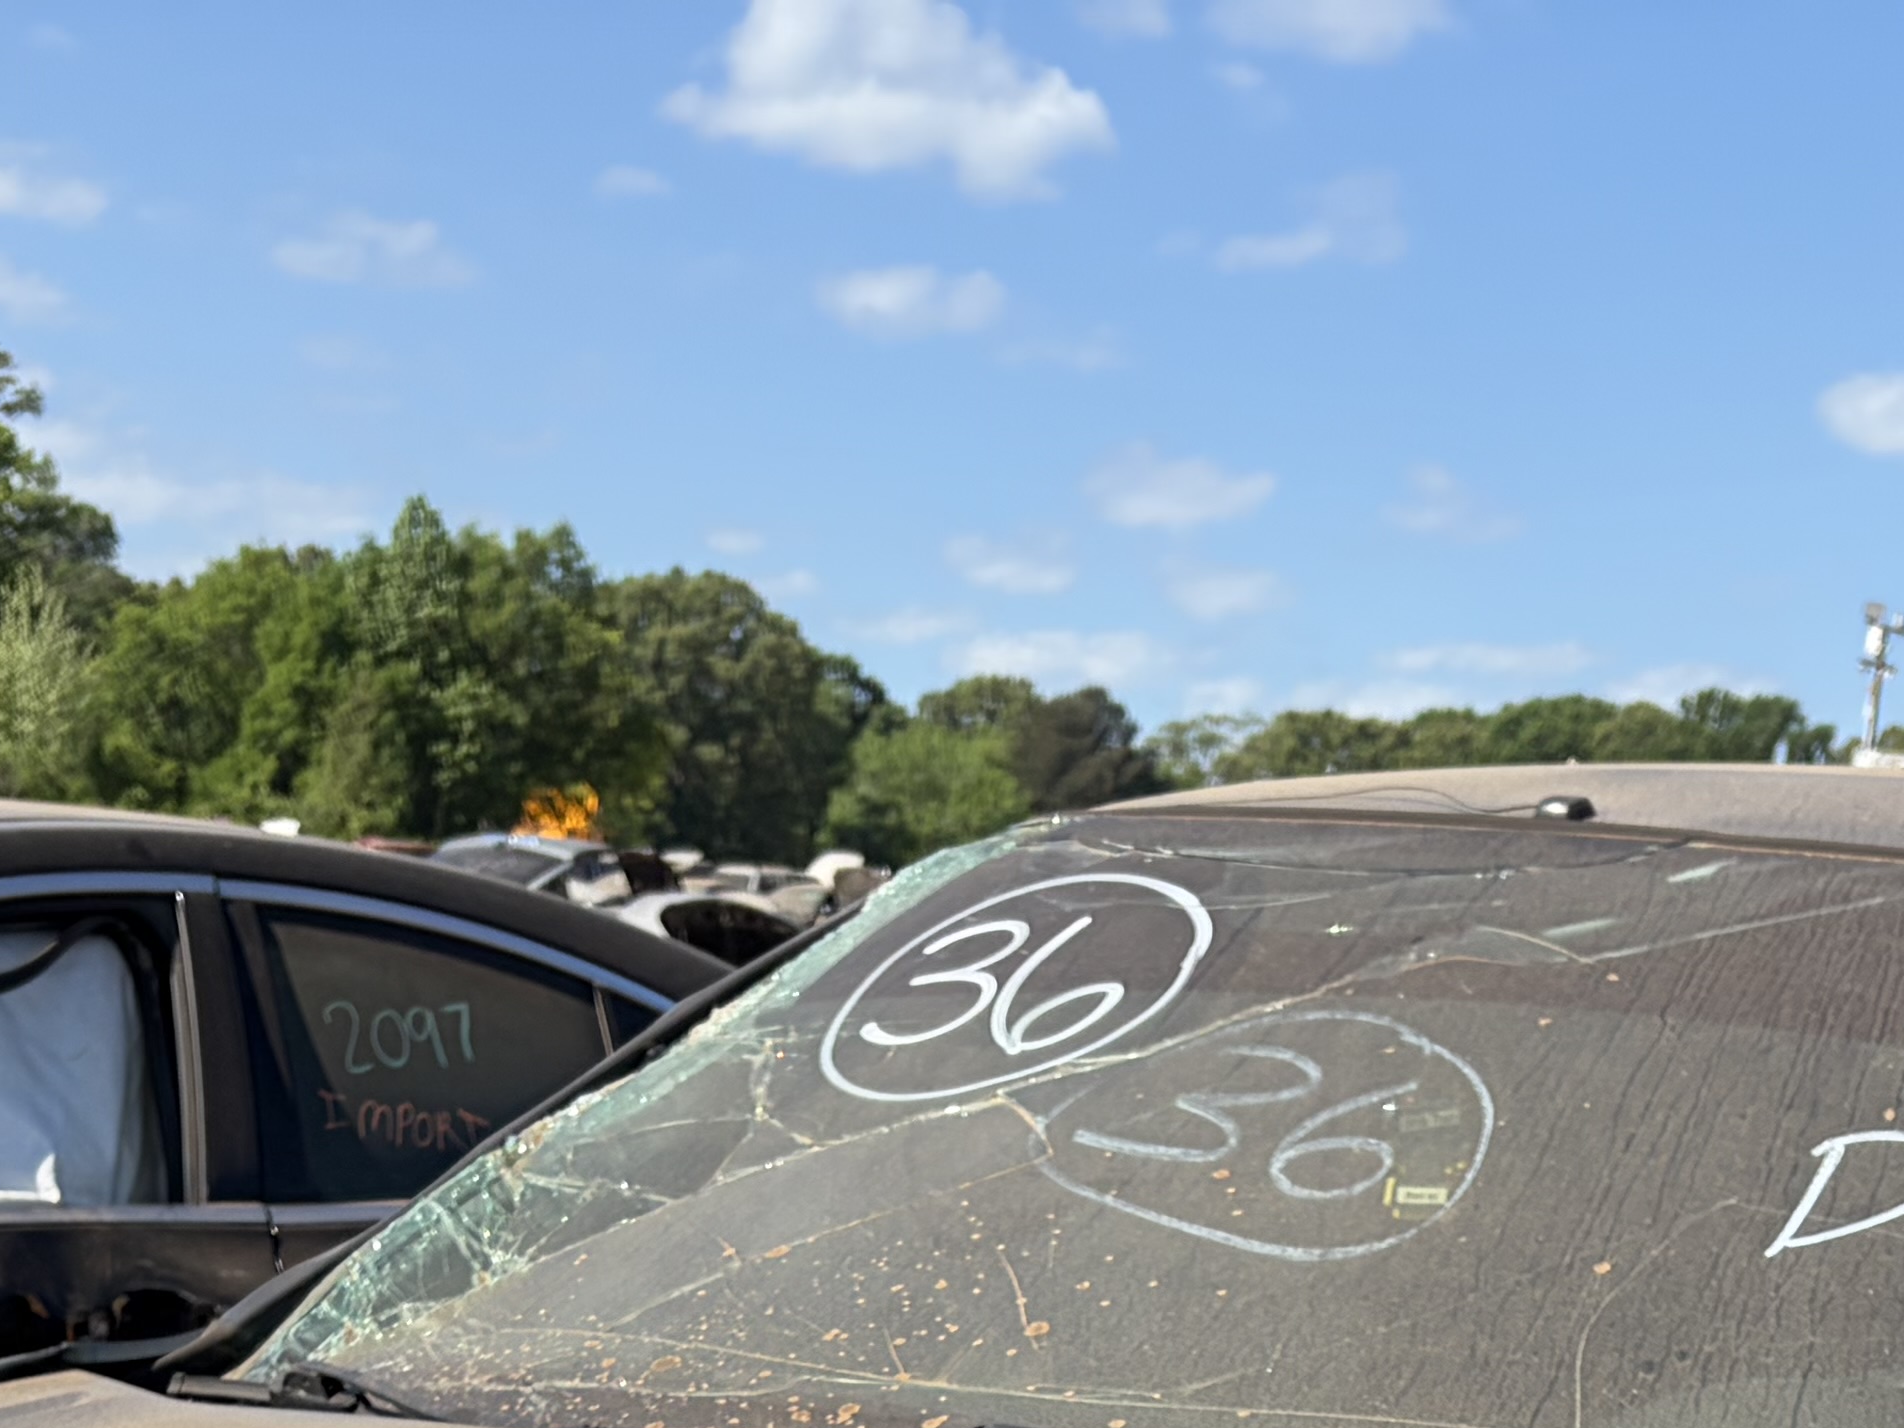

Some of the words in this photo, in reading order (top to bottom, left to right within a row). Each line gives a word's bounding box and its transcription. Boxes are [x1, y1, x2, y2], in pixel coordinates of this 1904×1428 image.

[322, 1000, 476, 1075] 2097
[860, 917, 1125, 1054] 36
[318, 1089, 490, 1151] IMPORT
[1074, 1046, 1419, 1200] 36
